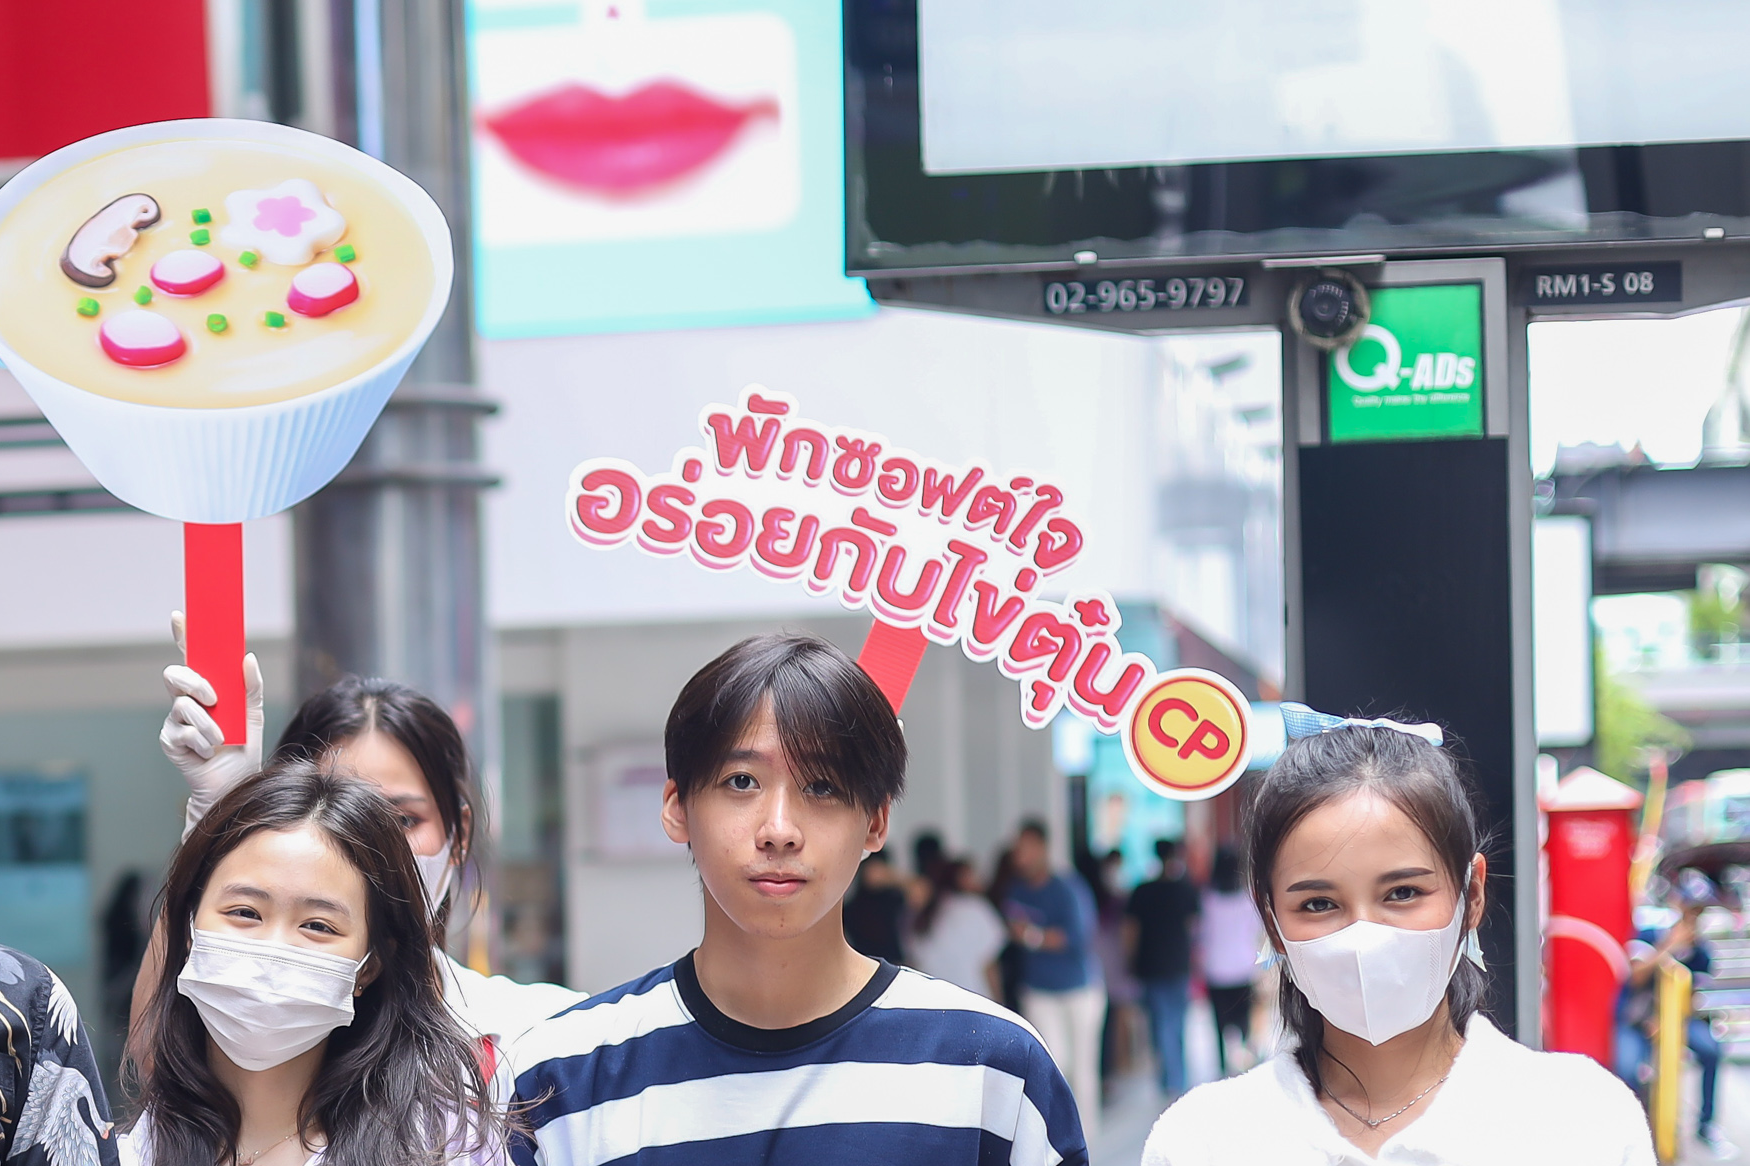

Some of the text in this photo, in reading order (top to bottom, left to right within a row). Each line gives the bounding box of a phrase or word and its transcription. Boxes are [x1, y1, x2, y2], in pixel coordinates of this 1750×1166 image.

[1046, 277, 1244, 314] 02-965-9797
[1536, 272, 1654, 298] RM1-S 08
[1148, 698, 1230, 760] CP
